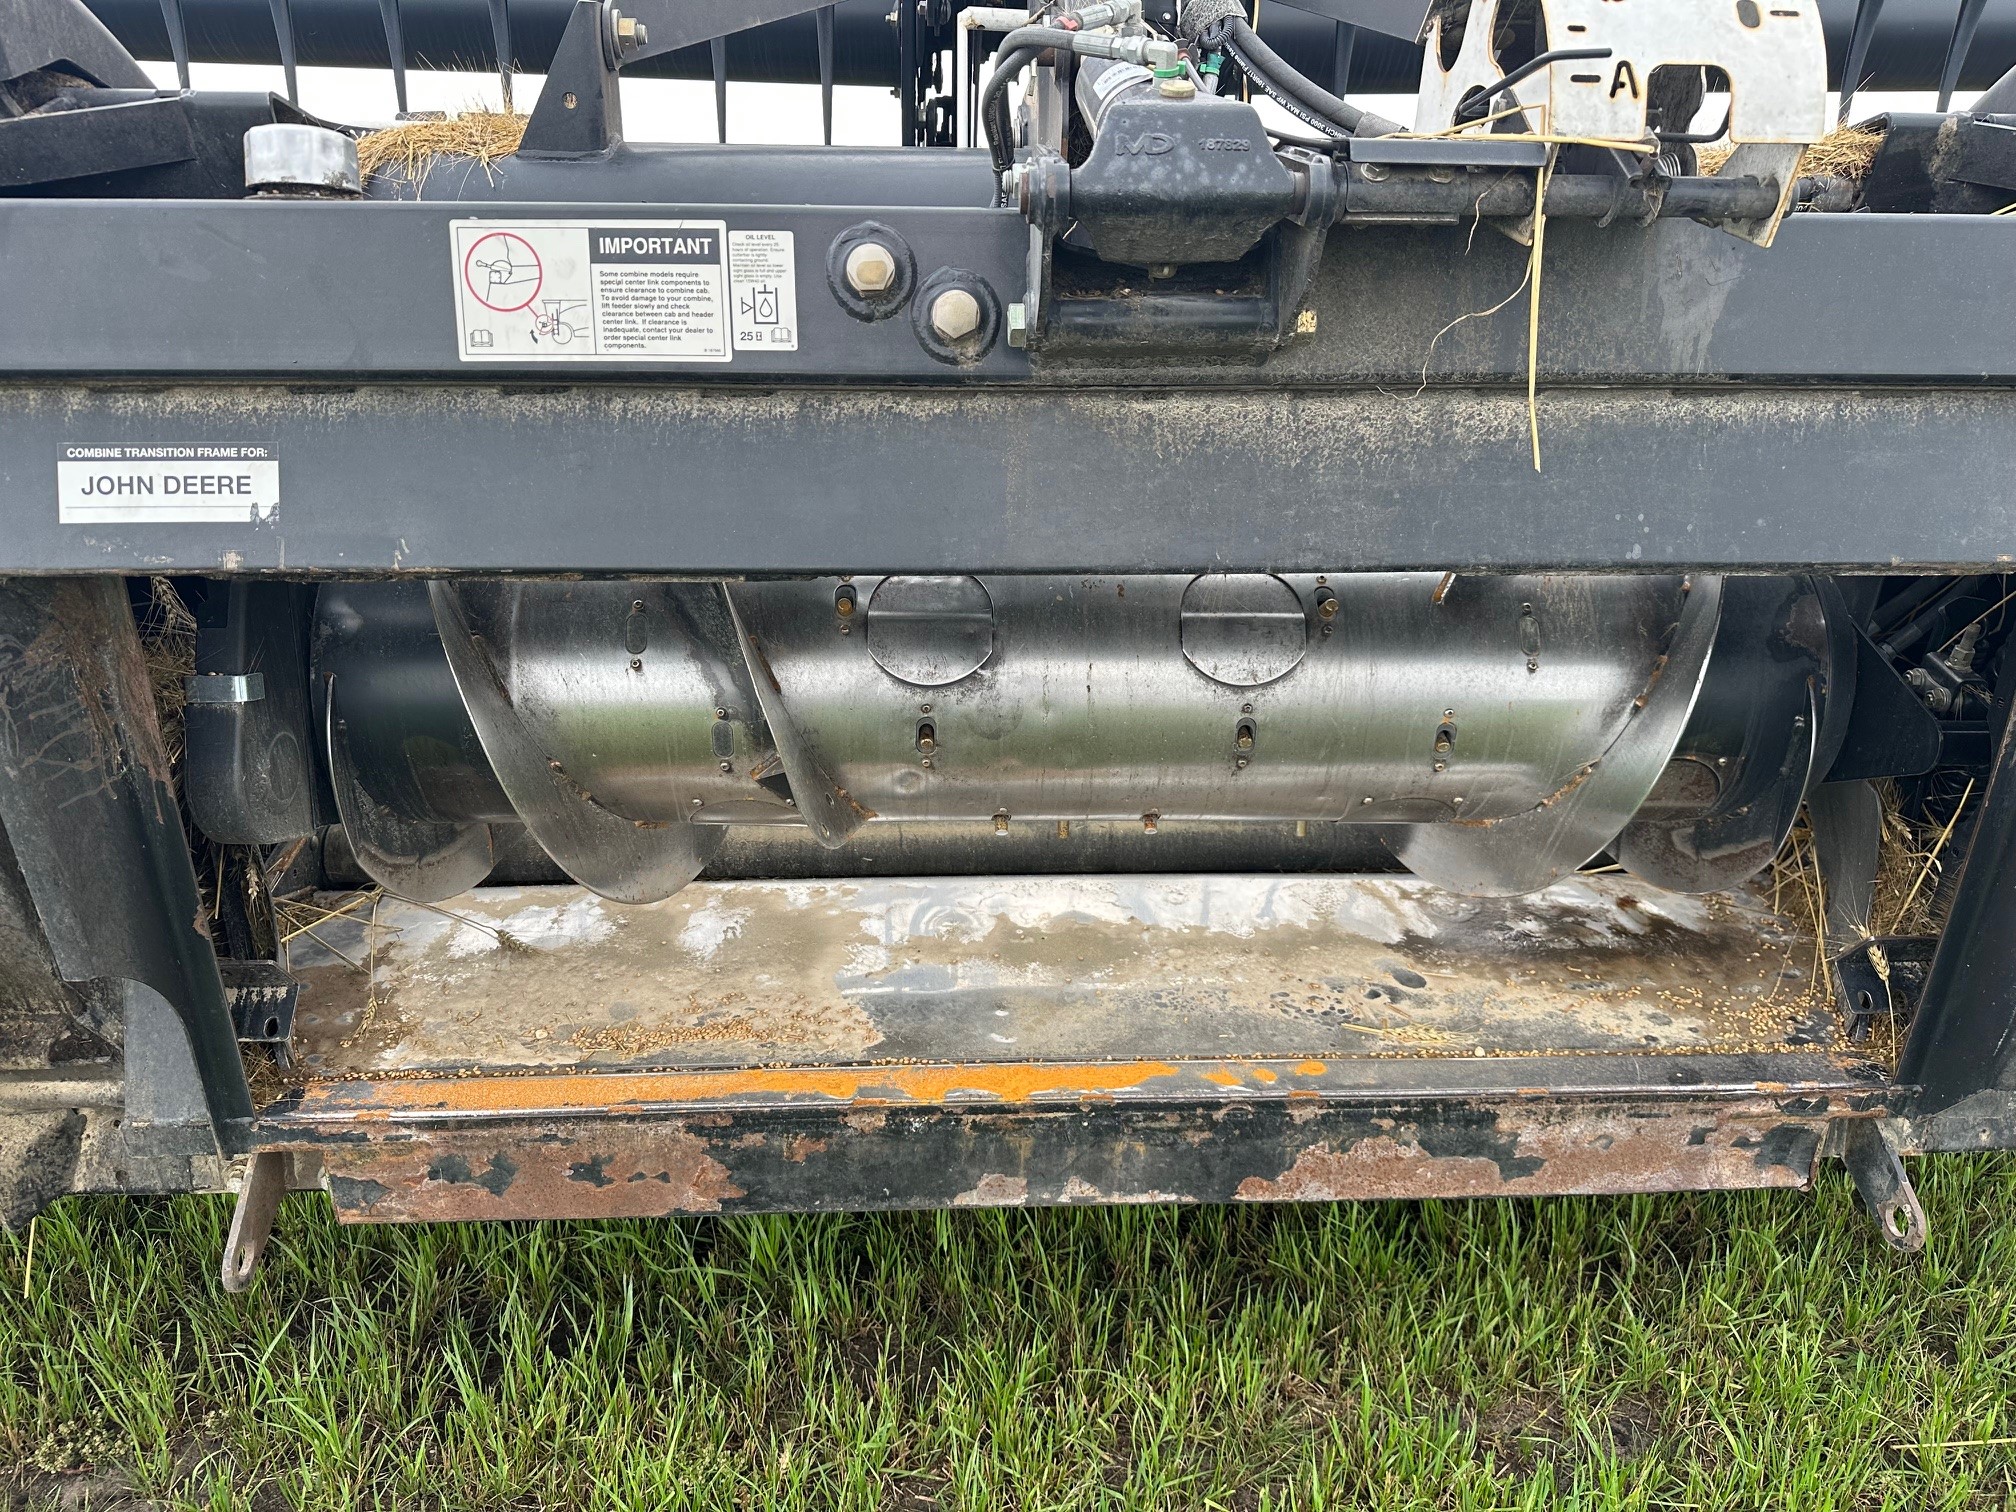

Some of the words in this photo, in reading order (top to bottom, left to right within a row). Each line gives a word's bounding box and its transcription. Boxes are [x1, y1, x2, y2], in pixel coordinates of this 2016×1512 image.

[1609, 60, 1638, 99] A
[1264, 86, 1277, 98] SAE
[1286, 102, 1300, 116] MAX
[1300, 111, 1311, 122] PSI
[599, 237, 712, 255] IMPORTANT
[675, 272, 699, 280] require
[600, 279, 623, 287] special
[661, 280, 701, 288] components
[631, 295, 656, 303] damage
[634, 303, 655, 311] slowly
[603, 327, 641, 335] inadequate,
[740, 331, 754, 341] 25
[66, 447, 123, 459] COMBINE
[124, 447, 196, 458] TRANSITION
[197, 447, 238, 458] FRAME
[240, 447, 268, 457] FOR:
[81, 475, 154, 496] JOHN
[164, 475, 252, 495] DEERE
